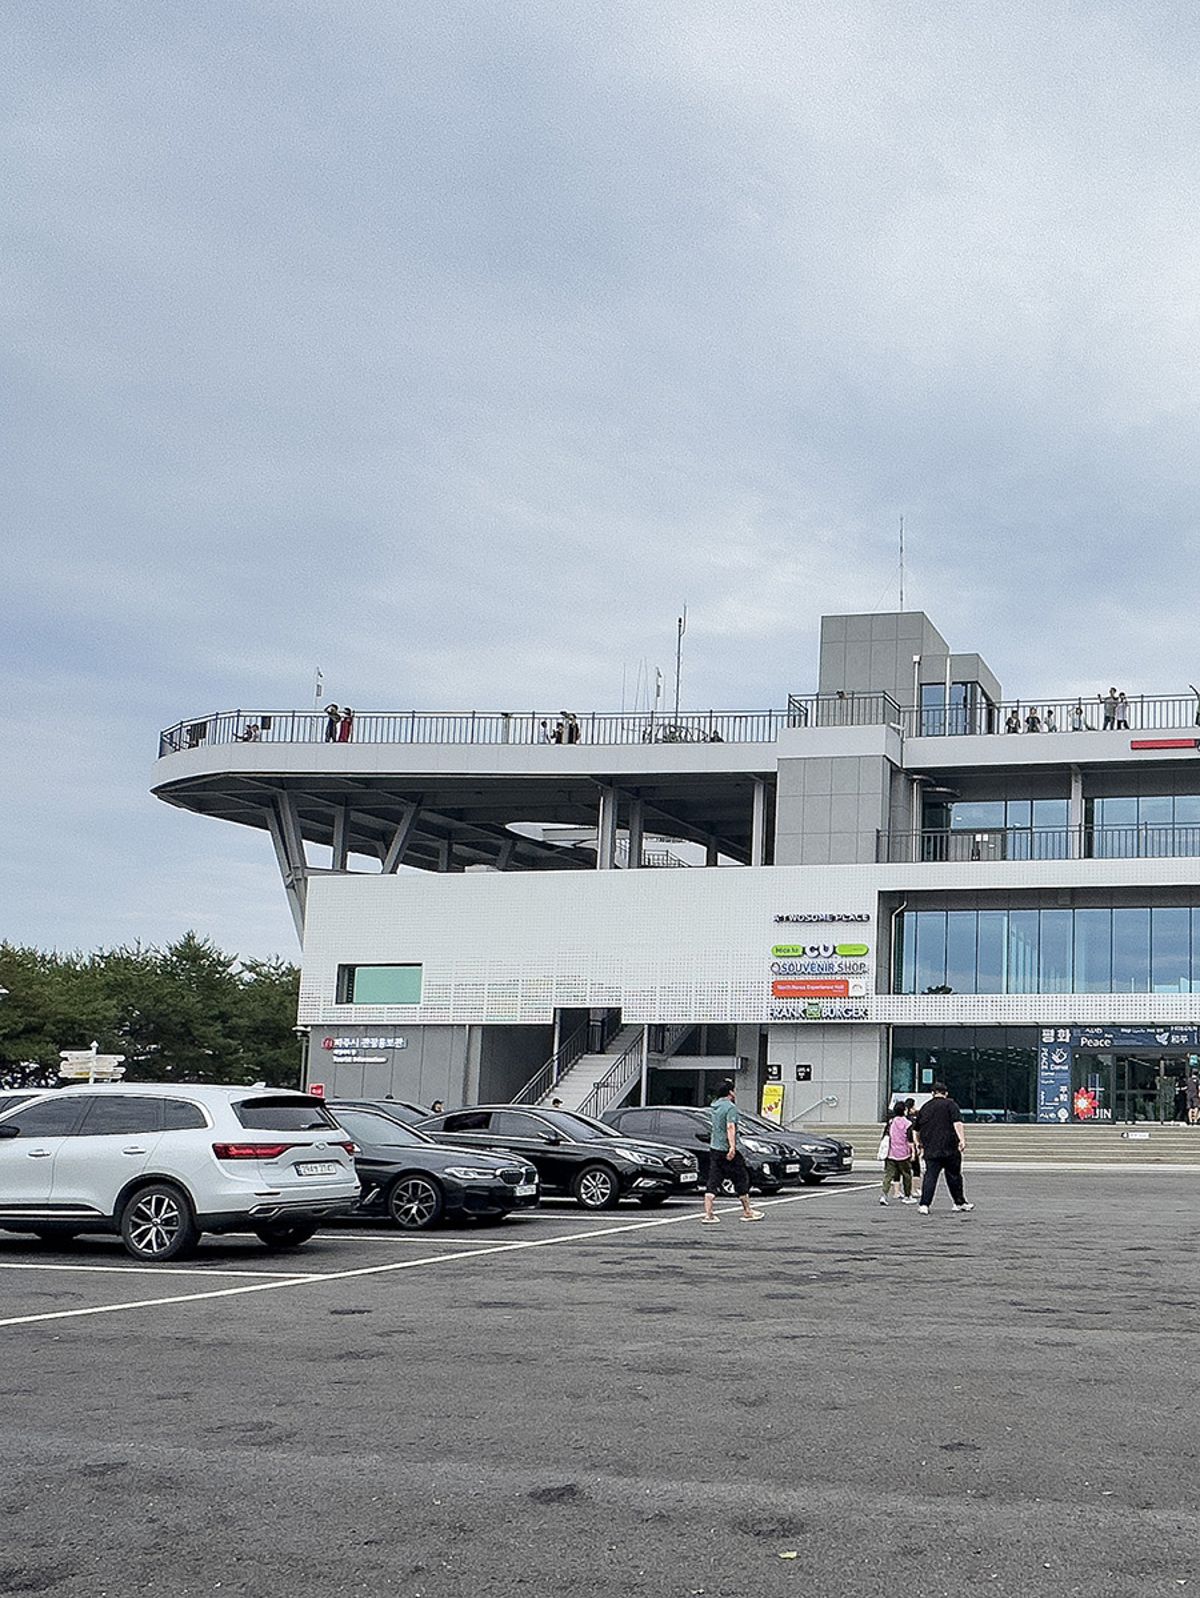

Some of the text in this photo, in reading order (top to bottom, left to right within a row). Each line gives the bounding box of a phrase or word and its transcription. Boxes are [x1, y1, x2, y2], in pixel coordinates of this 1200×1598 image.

[784, 914, 835, 922] TWOSOME
[835, 913, 870, 922] PLACE
[804, 944, 834, 959] CU
[781, 962, 866, 973] SOUVENIR SHOP
[769, 1008, 869, 1018] FRANK BURGER
[1041, 1028, 1071, 1043] 평화
[1080, 1036, 1112, 1047] Peace
